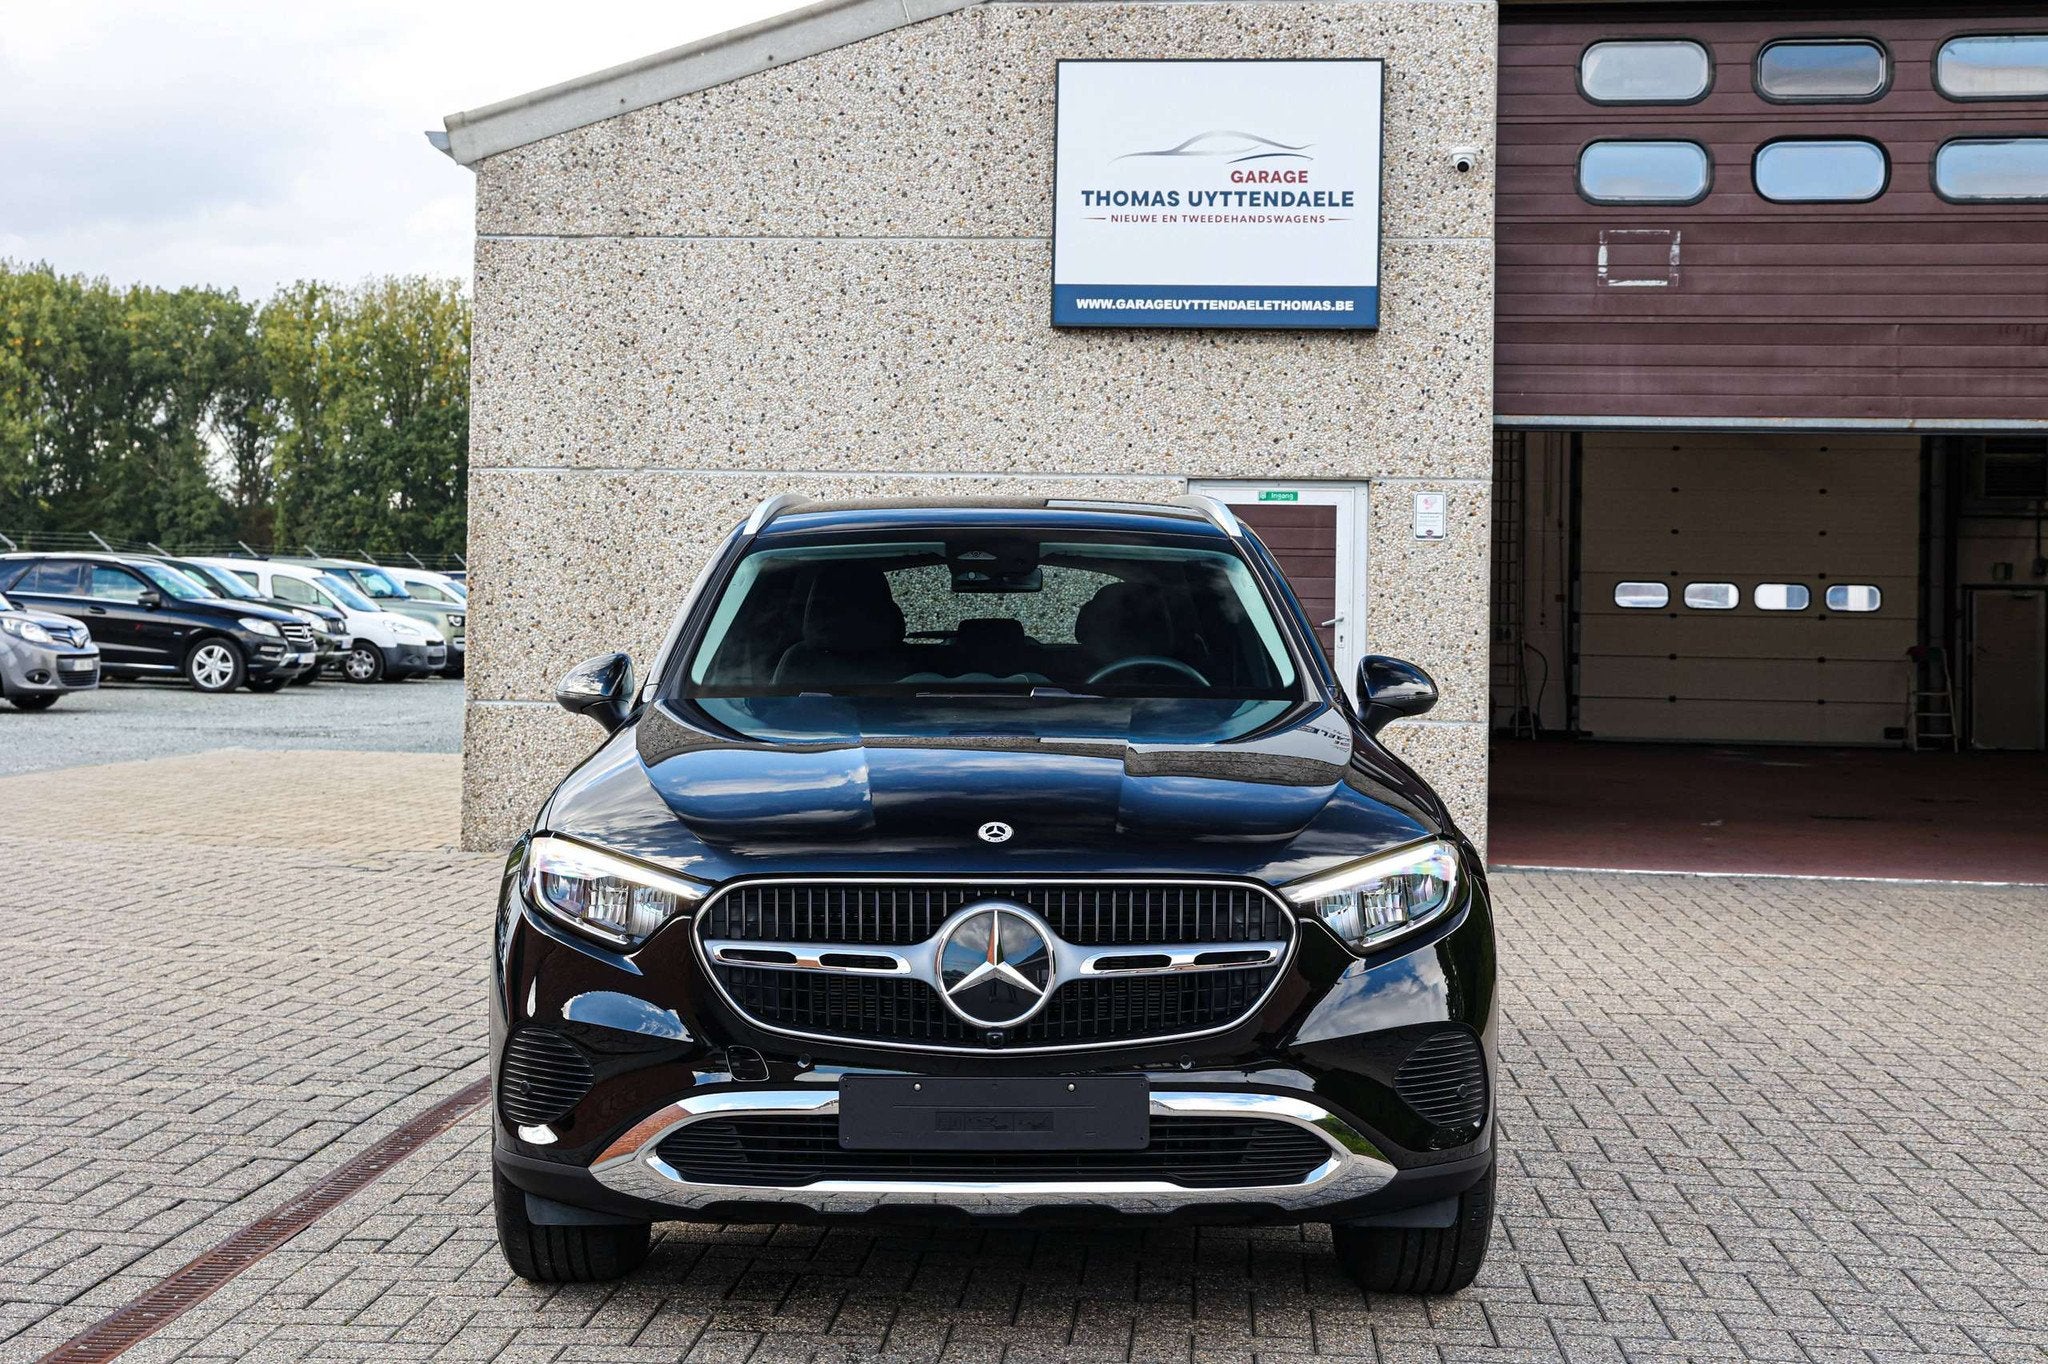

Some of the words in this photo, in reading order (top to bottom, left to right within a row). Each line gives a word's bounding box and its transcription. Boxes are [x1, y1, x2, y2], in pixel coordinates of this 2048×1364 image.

[1231, 170, 1308, 184] GARAGE
[1081, 190, 1180, 207] THOMAS
[1188, 190, 1354, 207] UYTTENDAELE
[1110, 214, 1157, 223] NIEUWE
[1162, 214, 1177, 223] EN
[1182, 214, 1326, 224] TWEEDEHANDSWAGENS
[1076, 298, 1354, 312] WWW.GARAGEUYTTENDAELETHOMAS.BE
[1271, 492, 1294, 501] Ingang
